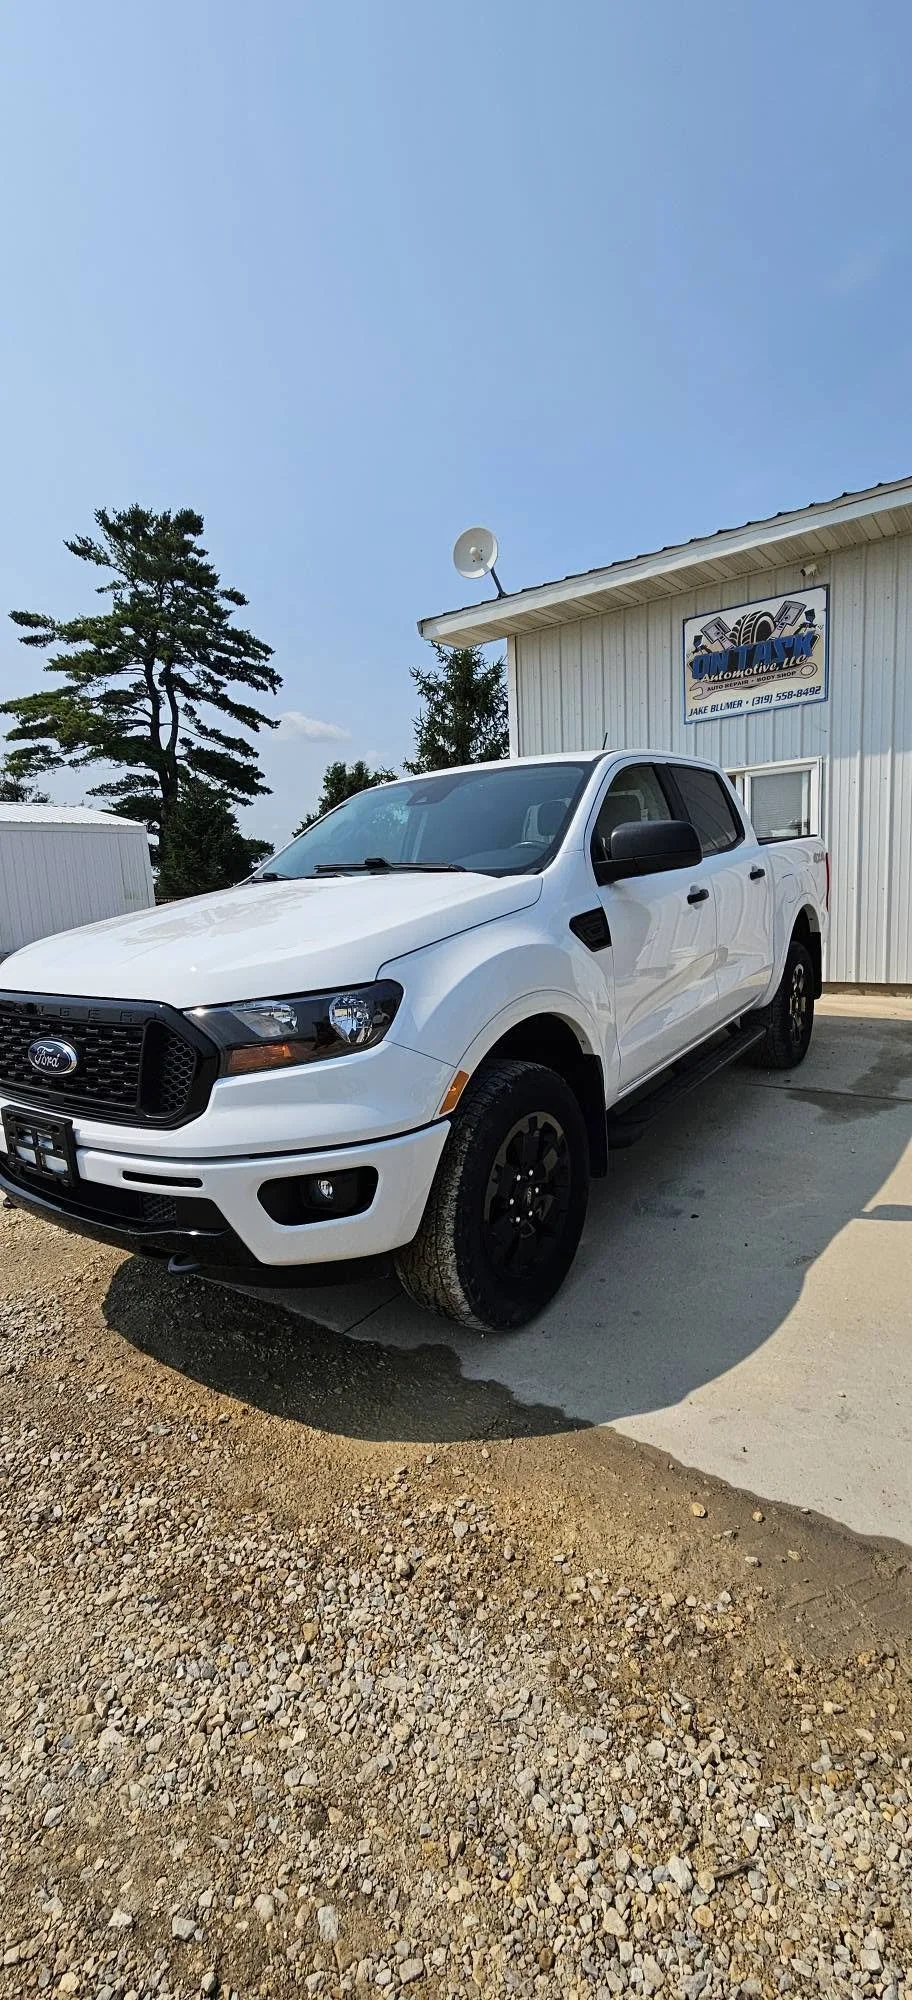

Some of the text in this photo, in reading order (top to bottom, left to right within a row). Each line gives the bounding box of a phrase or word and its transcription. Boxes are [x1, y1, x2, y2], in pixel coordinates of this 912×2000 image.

[692, 630, 815, 680] ON TASK
[701, 661, 779, 682] Automotive,
[706, 670, 797, 692] AUTO REPAIR BODY SHOP
[688, 705, 709, 717] JAKE
[752, 694, 774, 706] (319)
[775, 685, 822, 701] 558-8492
[34, 1045, 60, 1068] Ford
